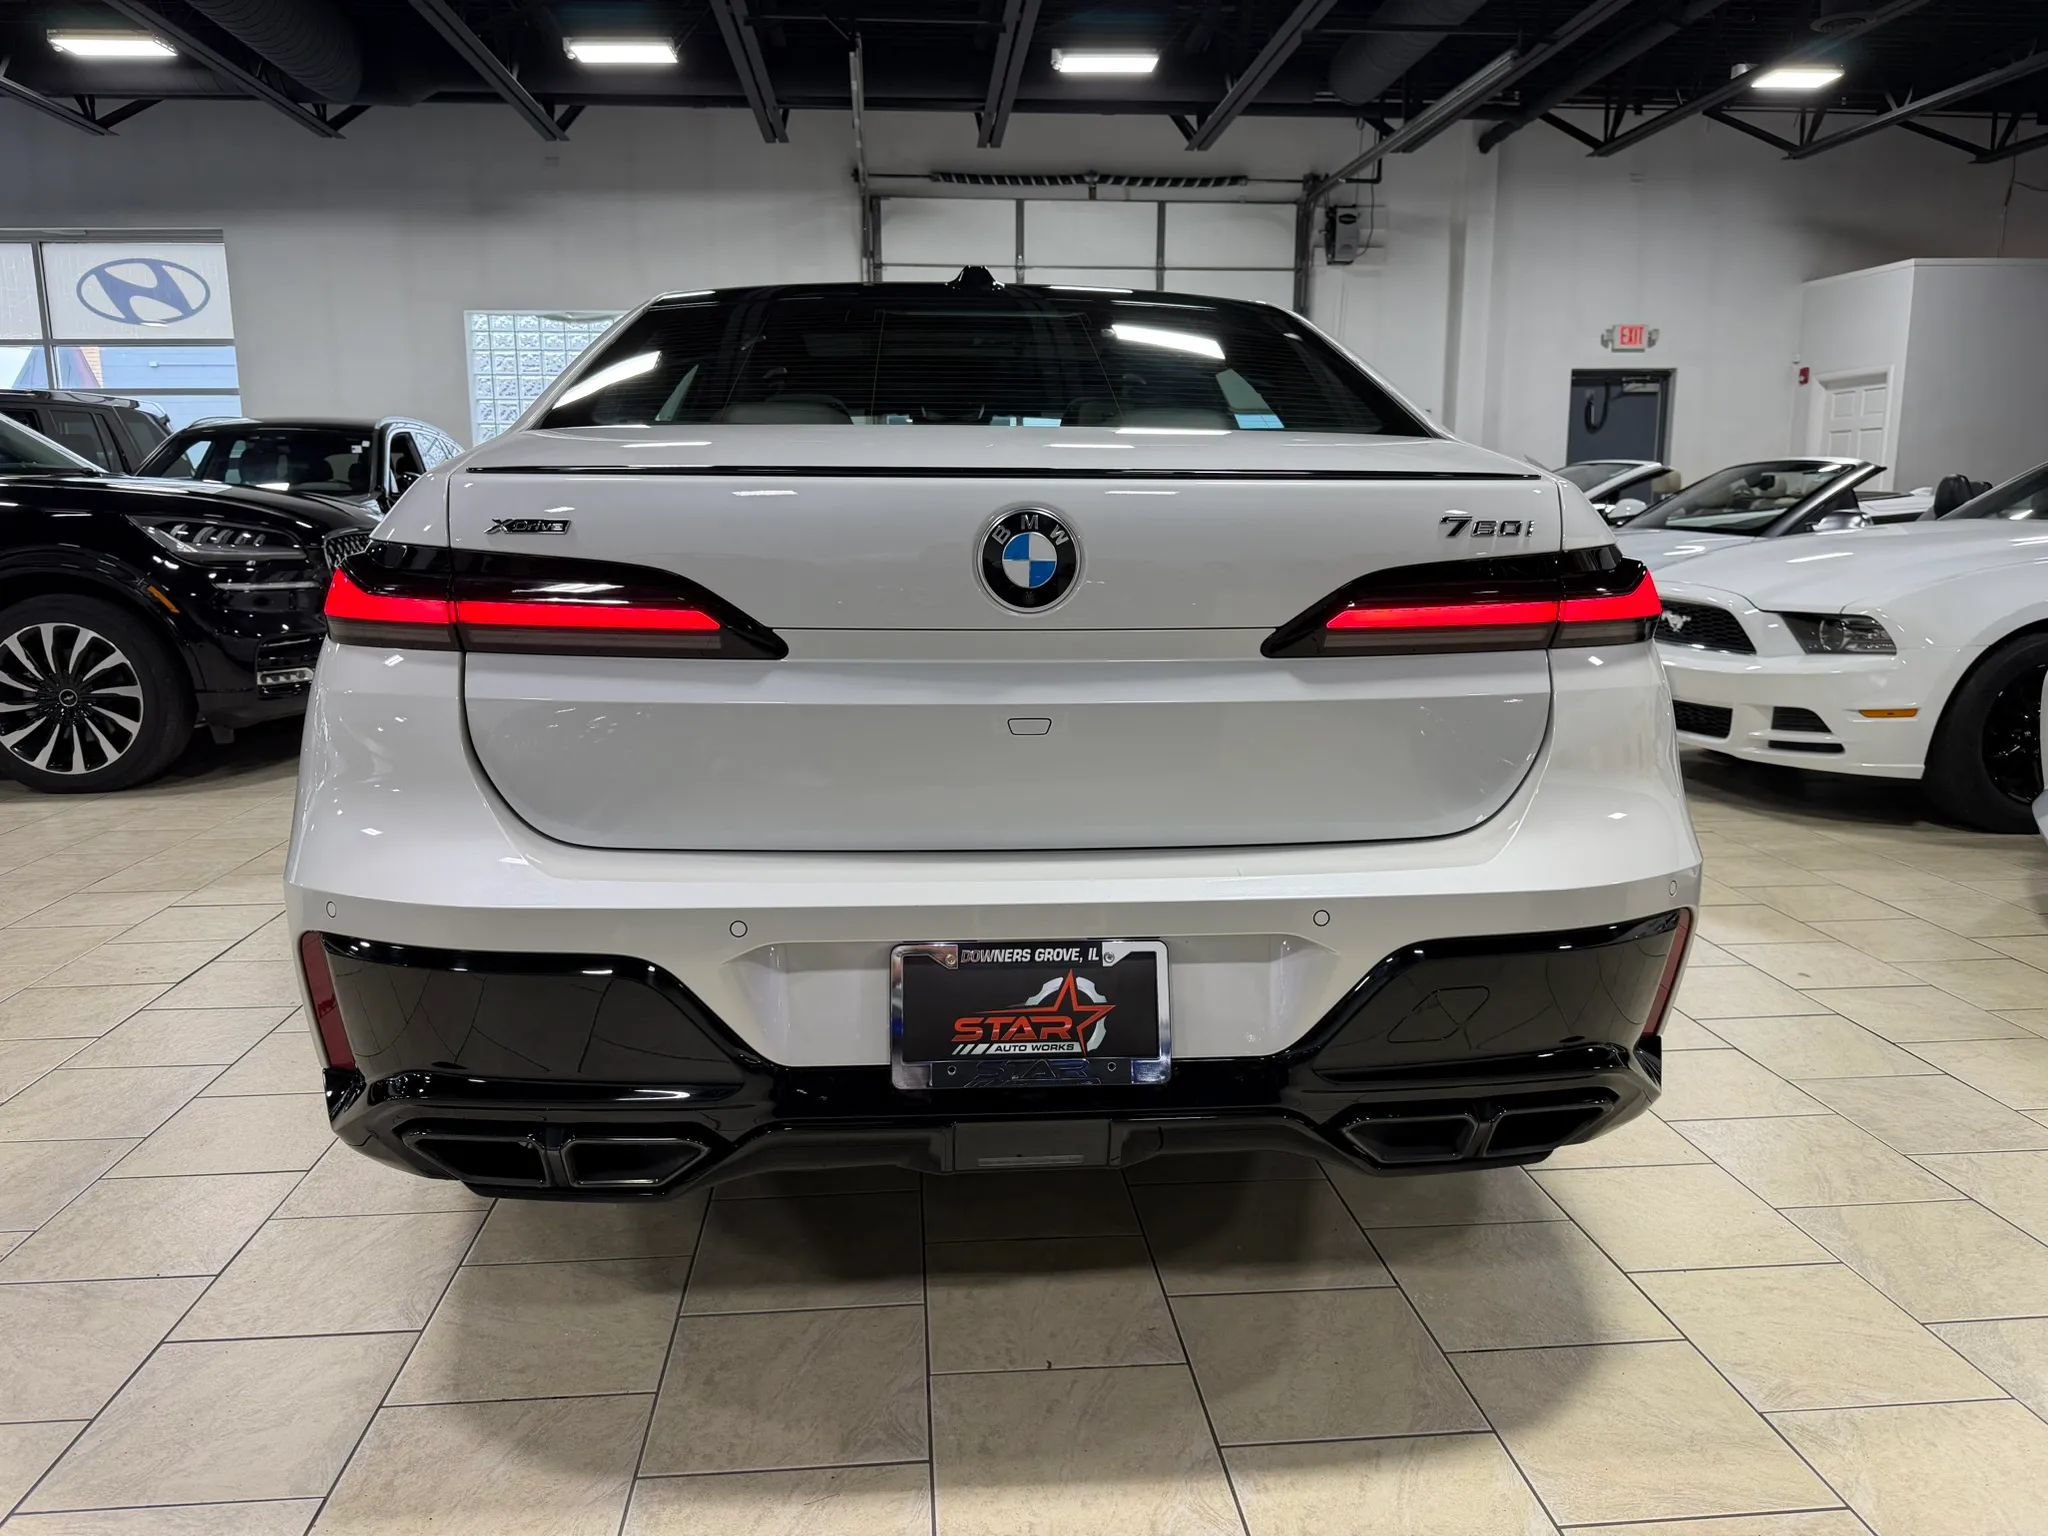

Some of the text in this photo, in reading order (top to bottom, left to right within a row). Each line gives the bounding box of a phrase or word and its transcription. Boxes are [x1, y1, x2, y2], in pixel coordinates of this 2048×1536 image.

[1620, 326, 1644, 345] EXIT
[991, 513, 1070, 546] BMW
[1440, 515, 1535, 538] 760i
[960, 947, 1100, 964] DOWNERS GROVE, IL
[951, 1015, 1074, 1042] STAR
[994, 1043, 1075, 1053] AUTO WORKS
